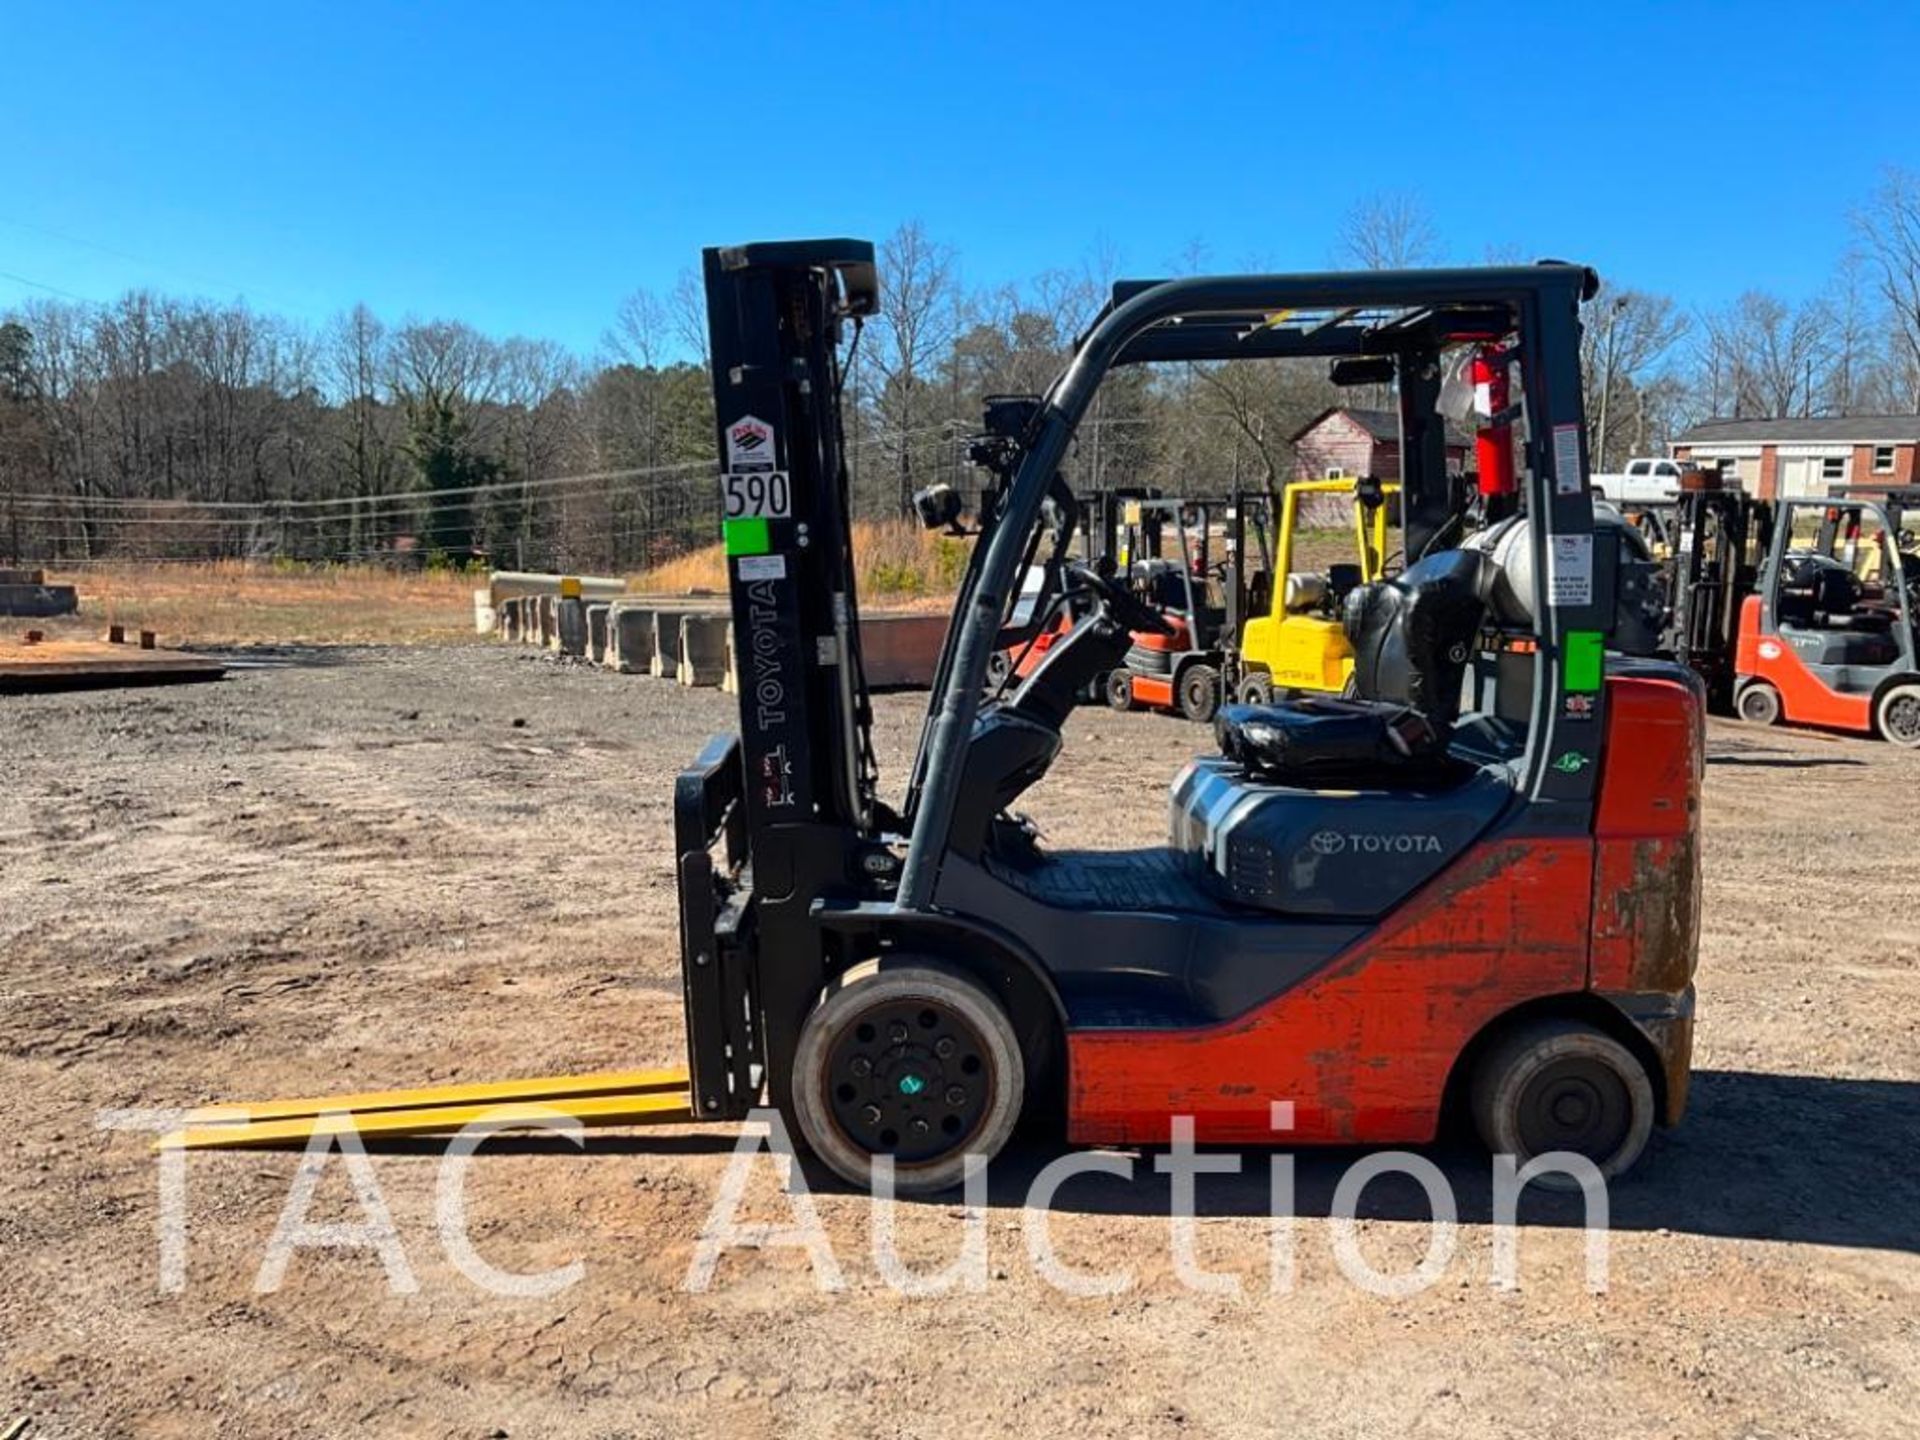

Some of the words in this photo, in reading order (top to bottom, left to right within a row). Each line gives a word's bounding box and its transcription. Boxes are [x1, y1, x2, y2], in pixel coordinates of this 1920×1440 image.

[726, 474, 788, 517] 590
[748, 578, 787, 731] TOYOTA
[1348, 834, 1442, 853] TOYOTA
